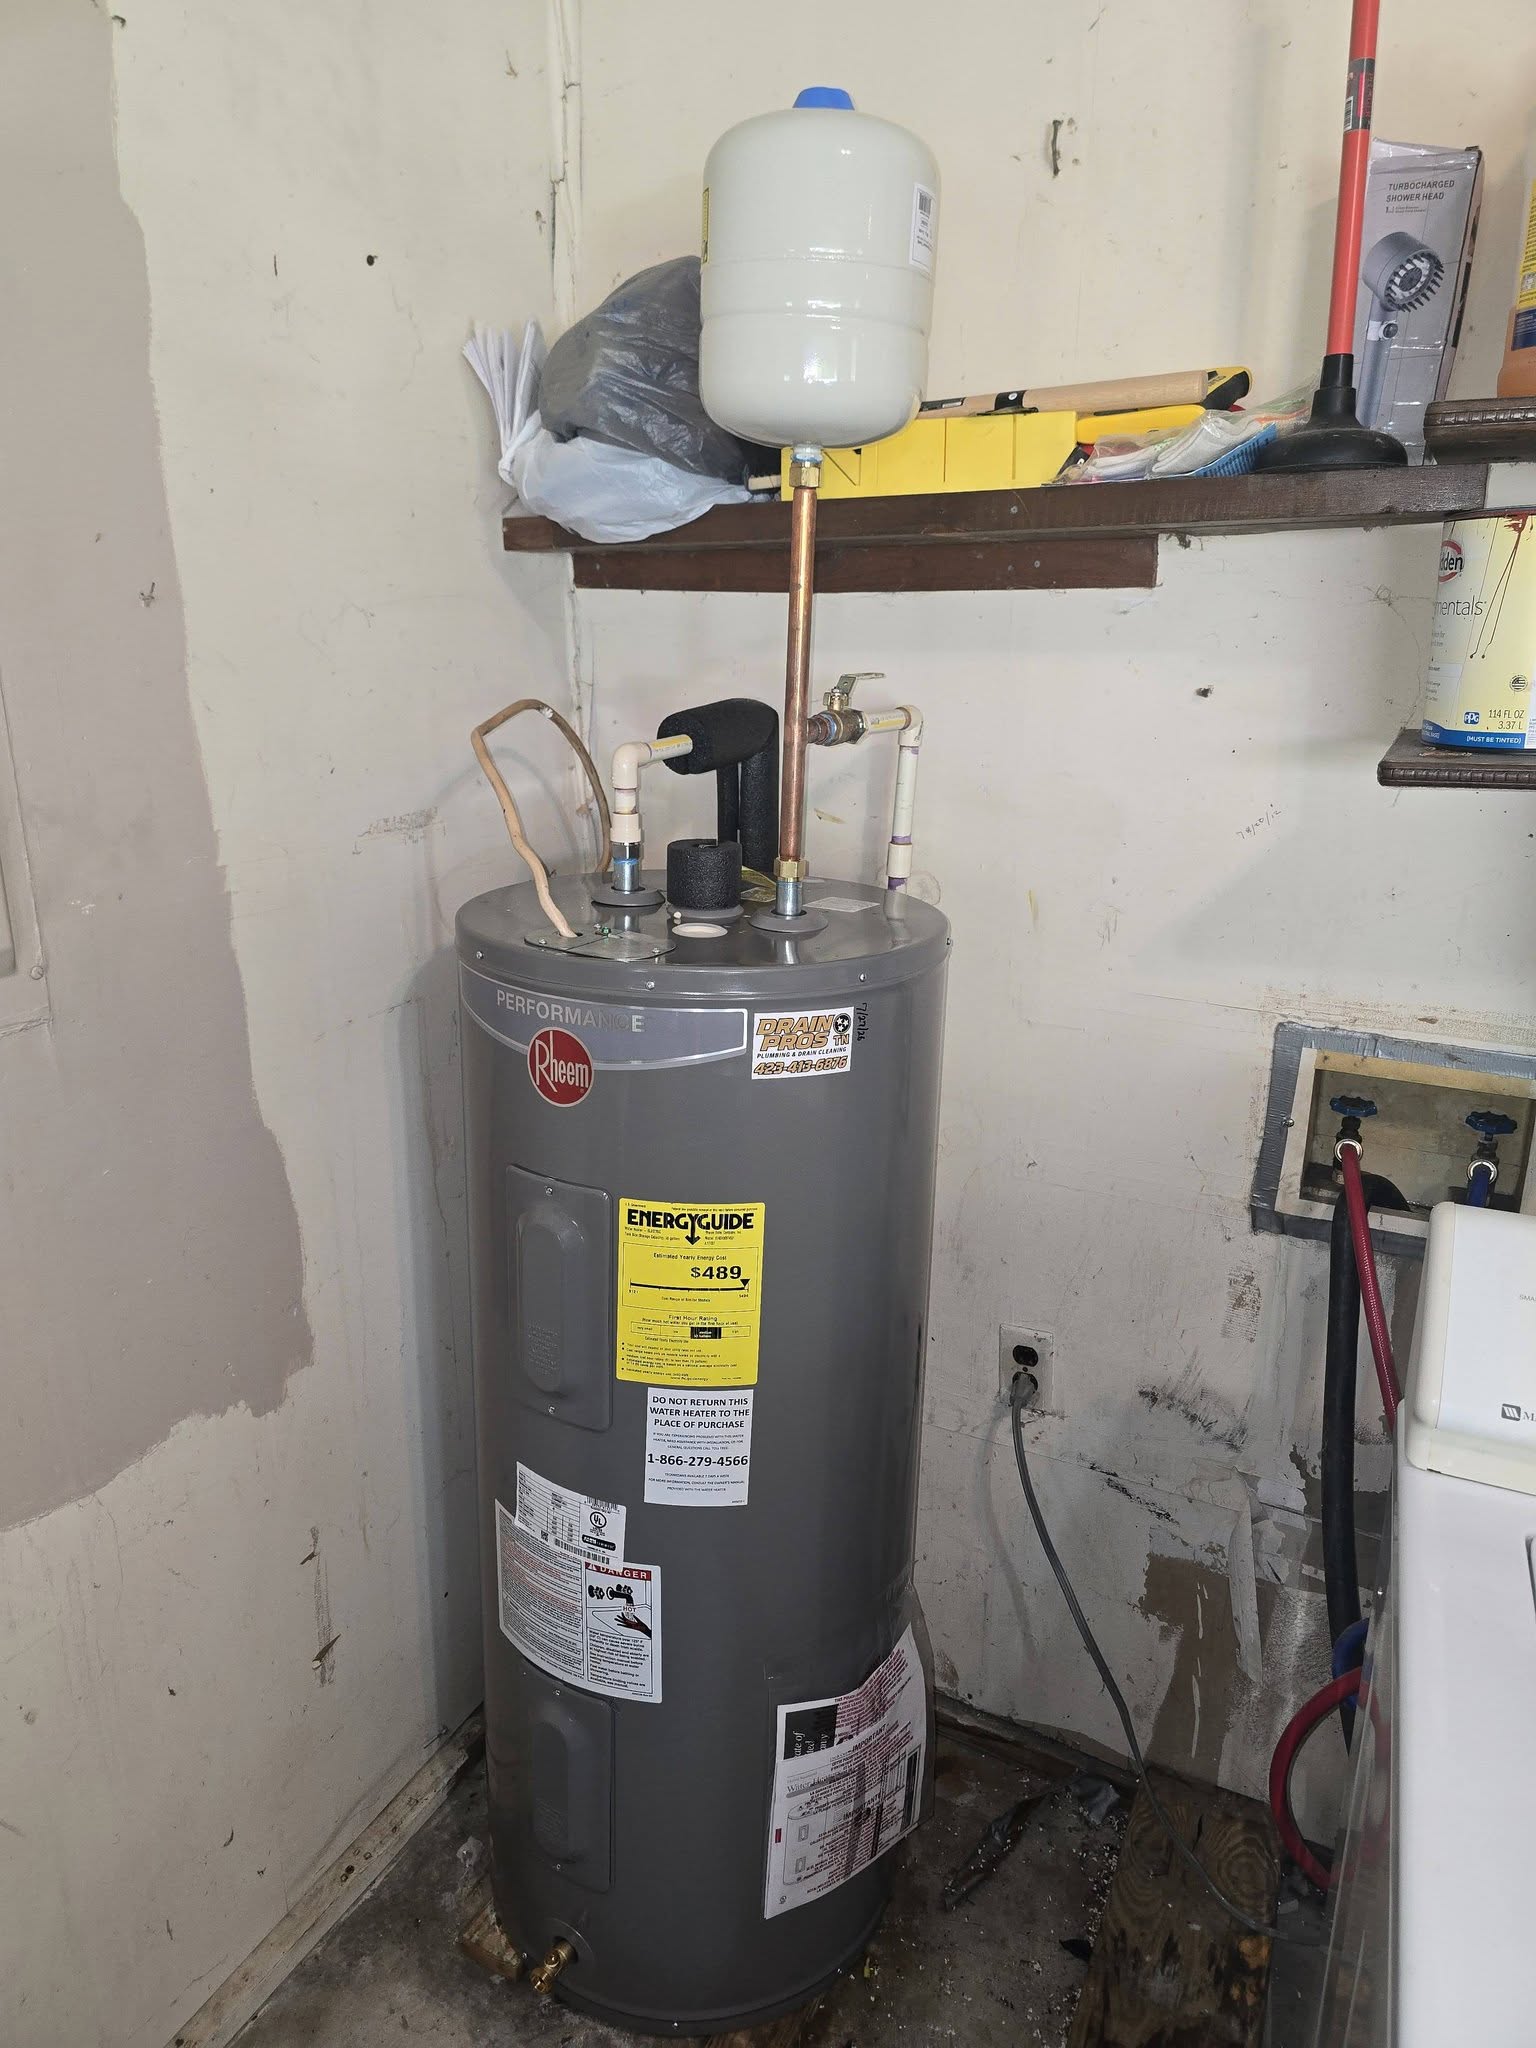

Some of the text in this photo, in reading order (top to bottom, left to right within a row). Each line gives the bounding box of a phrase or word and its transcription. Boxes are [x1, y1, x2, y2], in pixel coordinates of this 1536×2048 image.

[1388, 180, 1454, 191] TURBOCHARGED
[1386, 192, 1444, 203] SHOWER HEAD
[1489, 710, 1524, 718] 114 FL OZ
[1498, 720, 1522, 730] 3.37 L
[497, 989, 645, 1032] PERFORMANCE
[756, 1014, 835, 1036] DRAIN
[760, 1032, 850, 1052] PROS TN
[818, 1047, 846, 1055] CLEANING
[535, 1030, 588, 1093] Rheem
[754, 1056, 848, 1075] 423-413-6876
[628, 1209, 754, 1232] ENERGYGUIDE
[690, 1266, 742, 1280] $489
[1520, 1294, 1536, 1302] SMA
[652, 1396, 666, 1404] DO
[668, 1398, 688, 1406] NOT
[650, 1407, 680, 1416] WATER
[1524, 1411, 1536, 1422] M
[654, 1418, 681, 1428] PLACE
[698, 1420, 744, 1429] PURCHASE
[648, 1453, 748, 1467] 1-866-279-4566
[600, 1566, 647, 1580] DANGER
